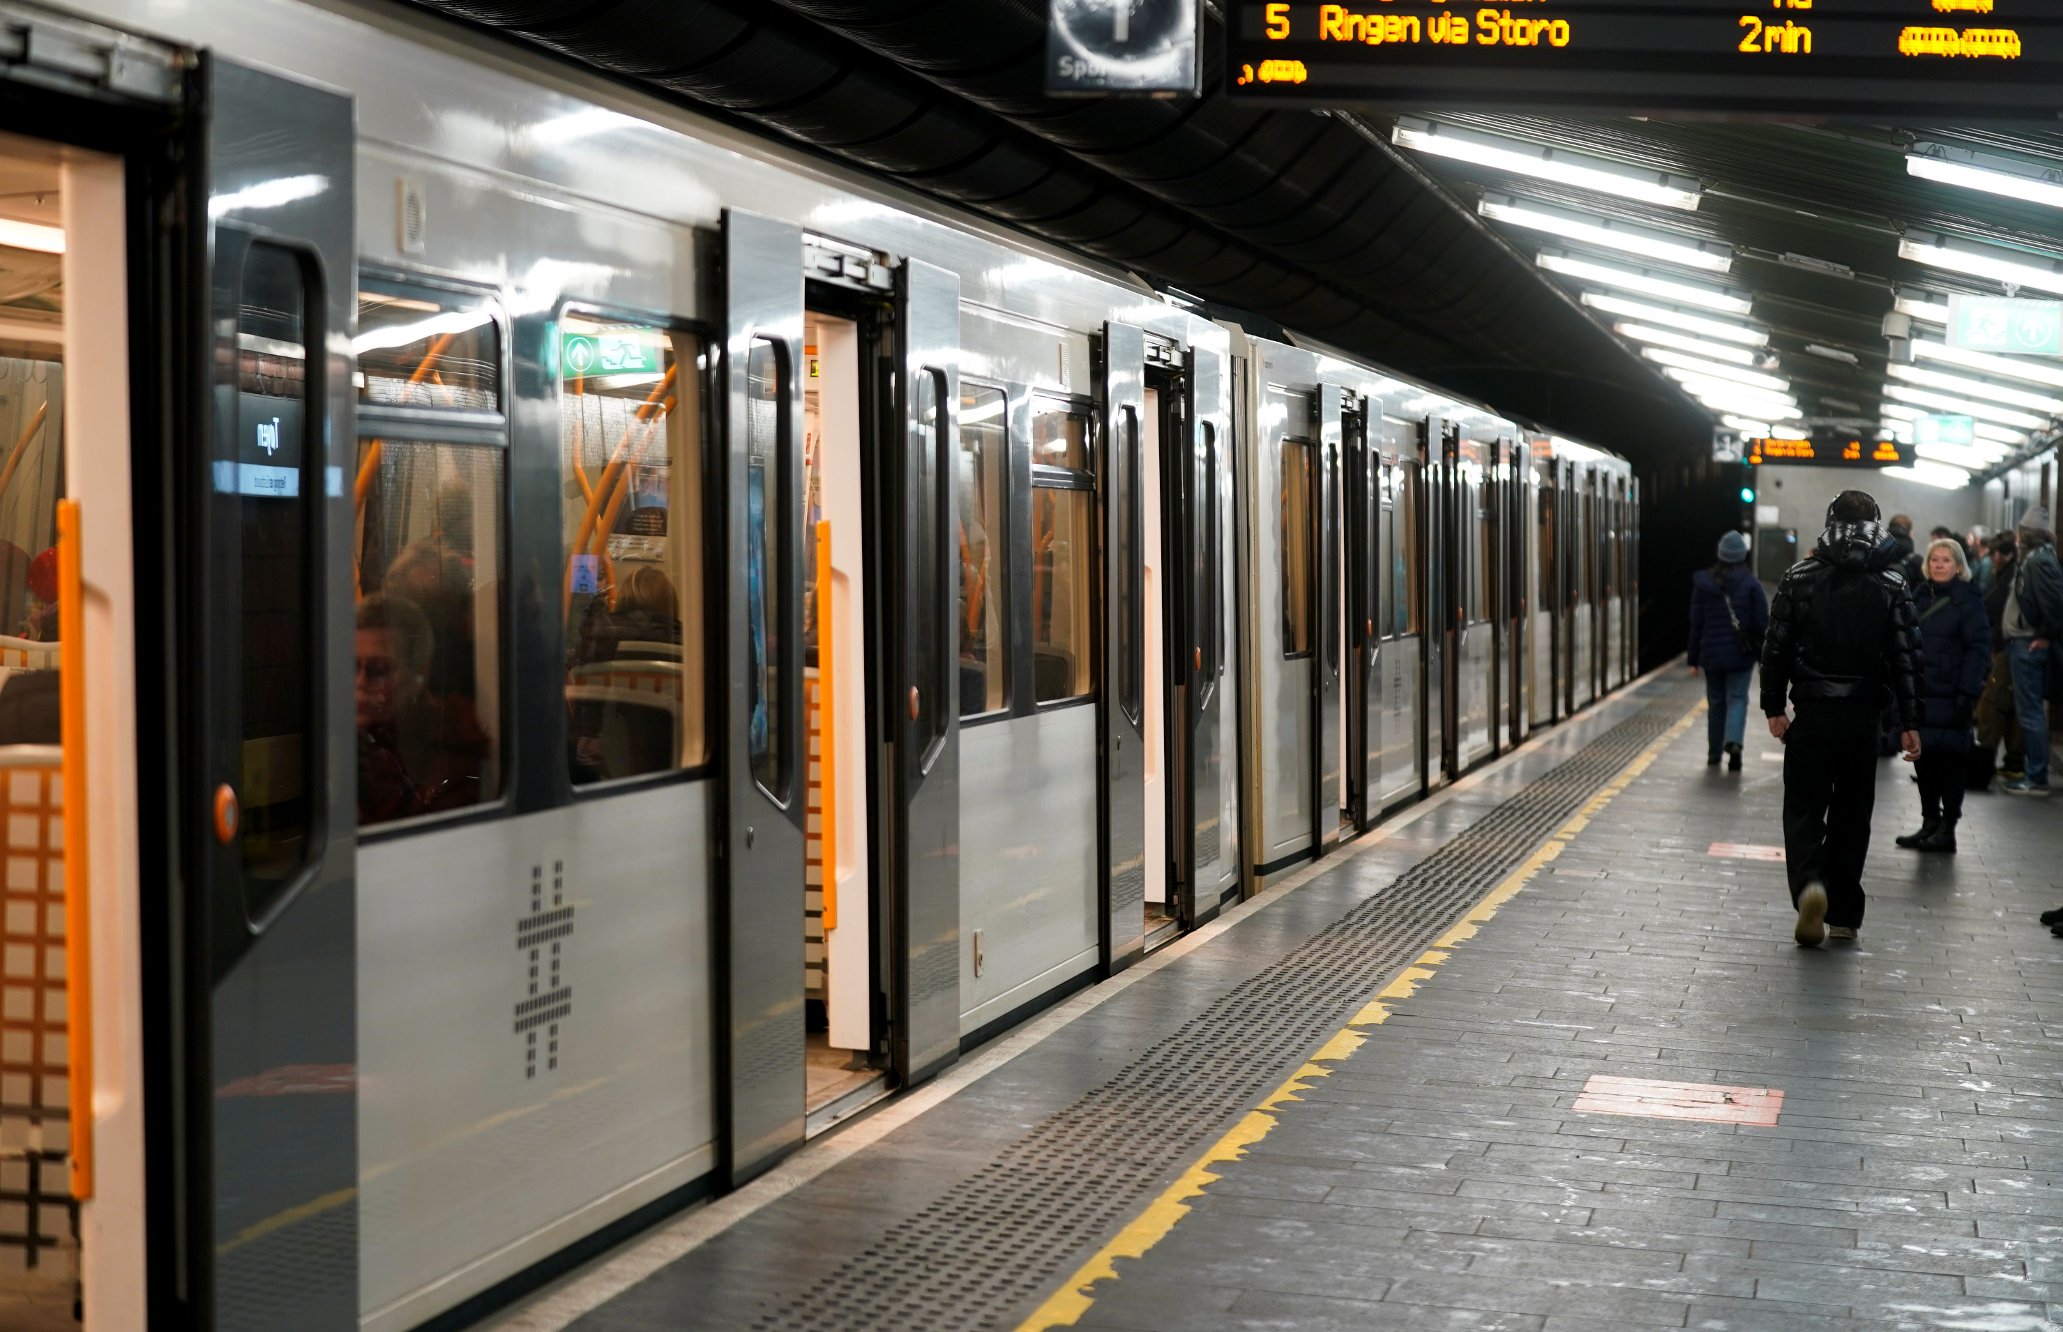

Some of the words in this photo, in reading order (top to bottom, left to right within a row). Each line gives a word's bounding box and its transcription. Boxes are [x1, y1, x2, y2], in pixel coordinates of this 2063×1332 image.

[1265, 3, 1290, 40] 5
[1319, 4, 1421, 46] Ringen
[1427, 10, 1470, 45] via
[1475, 8, 1570, 47] Storo
